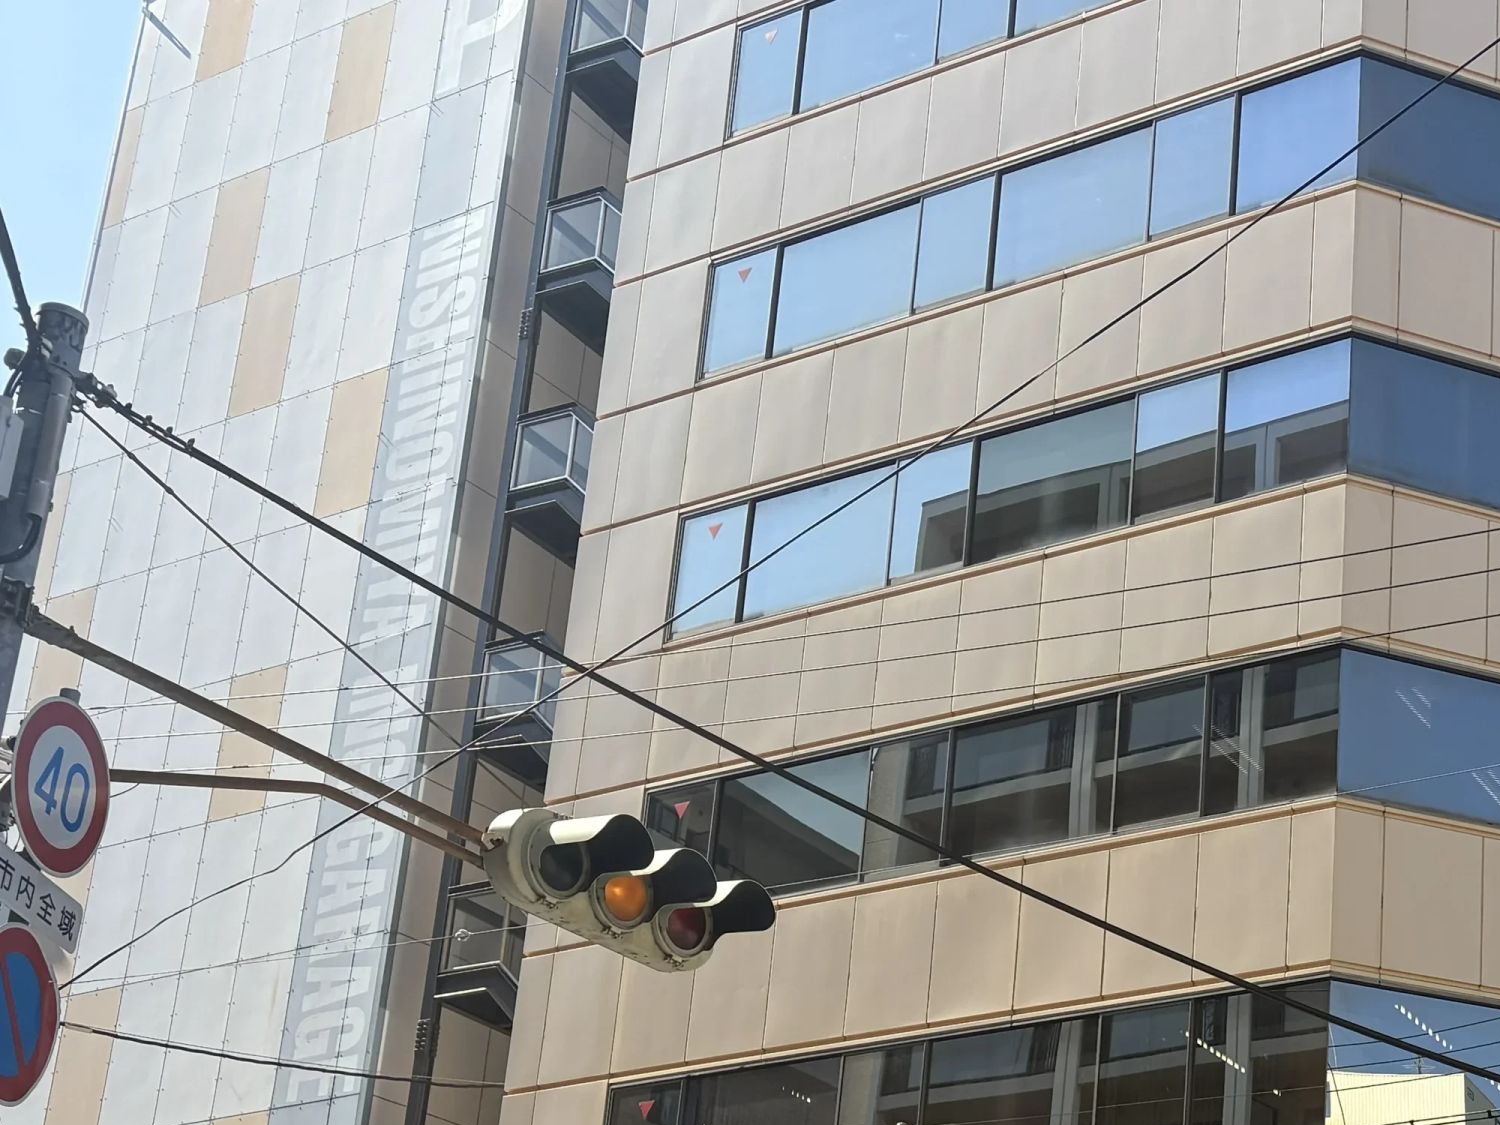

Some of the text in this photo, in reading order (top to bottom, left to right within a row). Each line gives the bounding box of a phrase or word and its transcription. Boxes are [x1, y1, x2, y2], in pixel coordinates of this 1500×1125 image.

[34, 746, 90, 833] 40
[0, 857, 76, 941] 市内全域
[286, 815, 394, 1102] GARAGE
